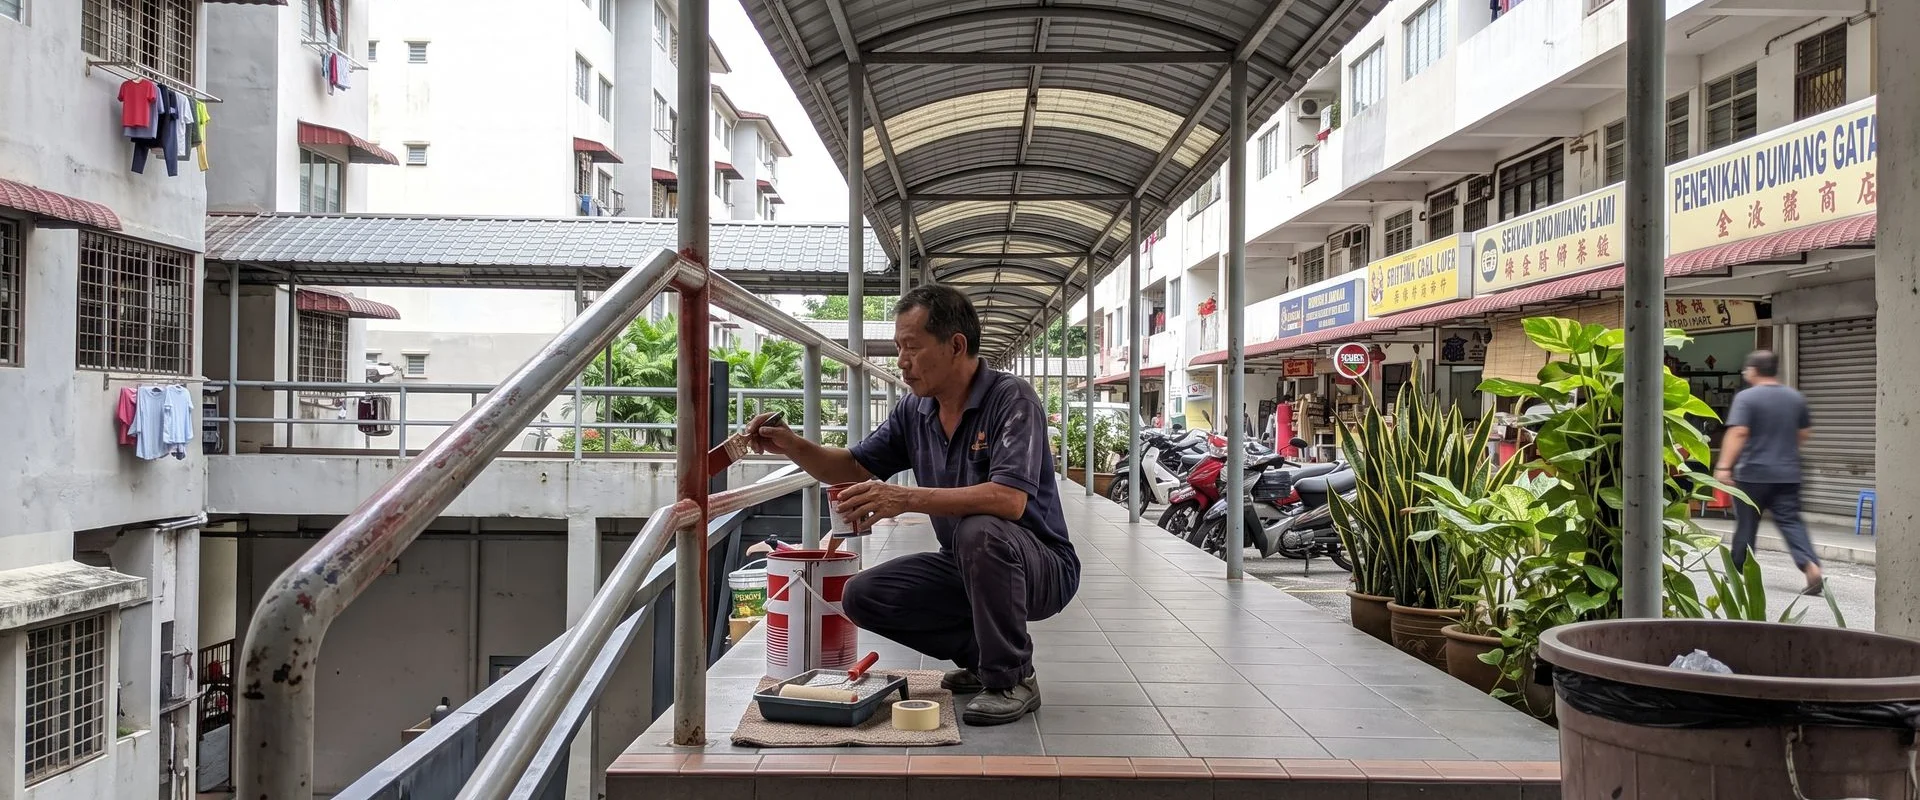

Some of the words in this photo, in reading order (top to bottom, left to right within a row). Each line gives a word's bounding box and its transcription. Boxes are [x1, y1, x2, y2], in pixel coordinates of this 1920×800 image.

[1675, 154, 1750, 213] PENENIKAN
[1756, 130, 1827, 191] DUMANG
[1590, 194, 1616, 230] LAMI
